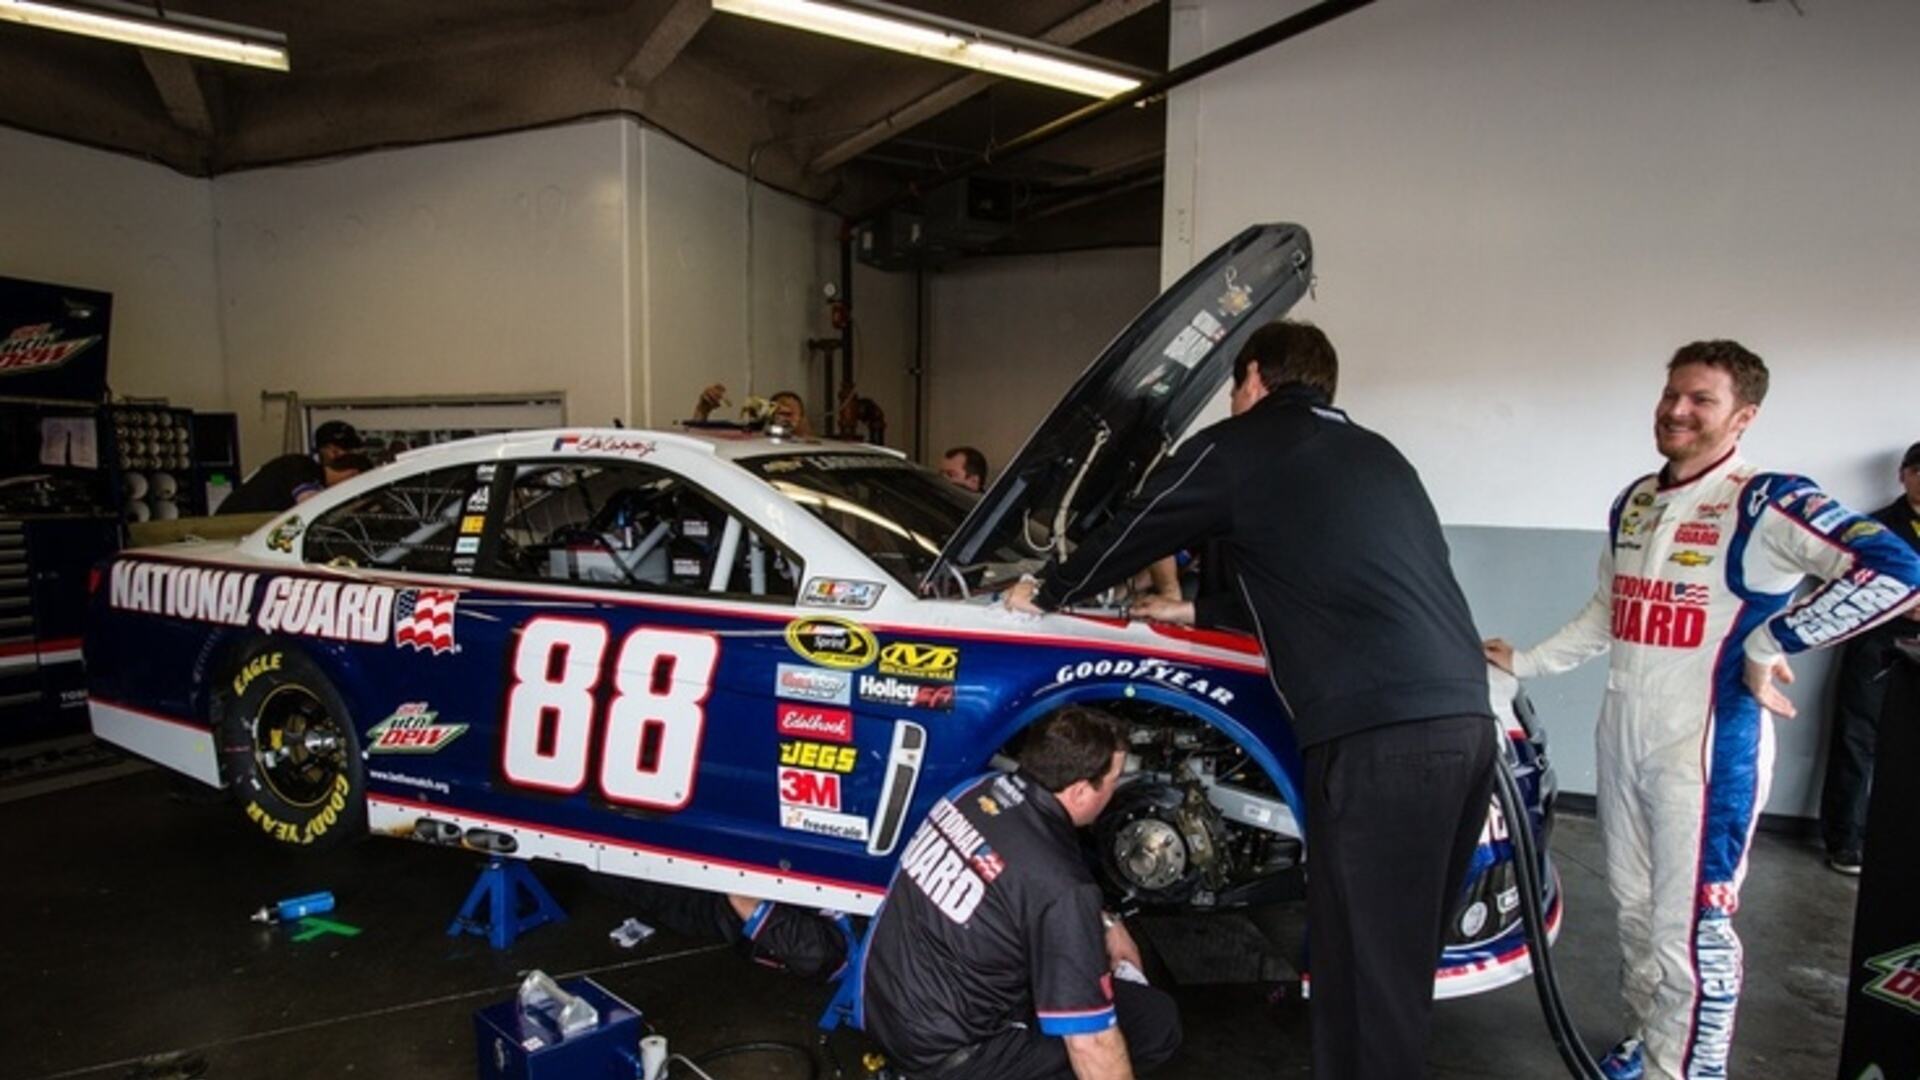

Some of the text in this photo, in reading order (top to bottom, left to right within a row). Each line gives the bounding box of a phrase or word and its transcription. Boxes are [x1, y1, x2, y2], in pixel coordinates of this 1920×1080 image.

[110, 560, 395, 643] NATIONAL GUARD
[1611, 597, 1706, 649] UARD
[1794, 574, 1911, 646] GUARD
[233, 652, 283, 697] EAGLE
[859, 675, 919, 707] Holley
[503, 614, 719, 811] 88
[779, 741, 858, 772] JEGS
[782, 771, 838, 809] 3M
[803, 818, 863, 837] freescale
[900, 813, 986, 924] UARD
